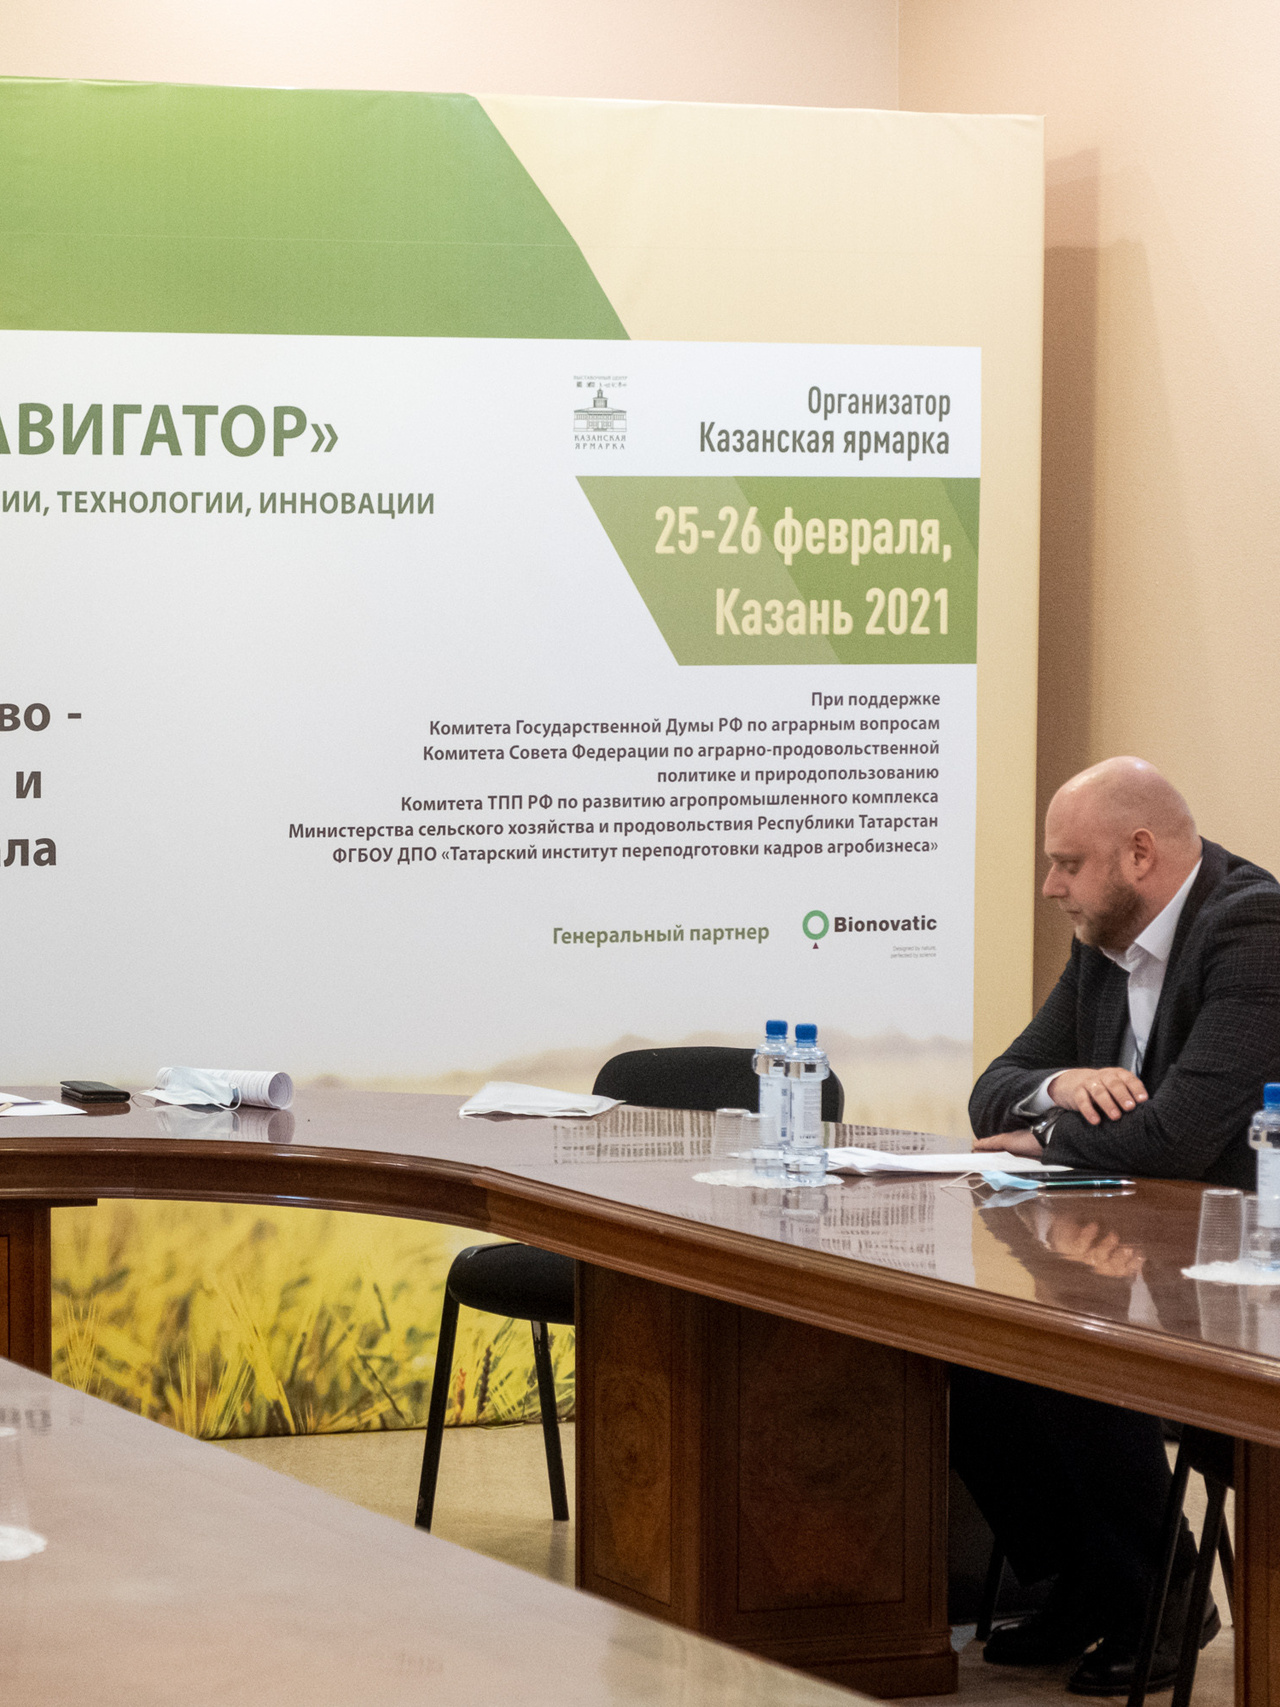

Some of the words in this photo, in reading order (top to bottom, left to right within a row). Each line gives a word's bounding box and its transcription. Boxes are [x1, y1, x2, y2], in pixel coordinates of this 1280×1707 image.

[807, 385, 951, 423] Организатор
[700, 421, 835, 454] Казанская
[843, 430, 950, 462] ярмарка
[56, 490, 252, 517] ТЕХНОЛОГИИ,
[259, 492, 434, 520] ИННОВАЦИИ
[655, 505, 762, 555] 25-26
[773, 506, 952, 566] февраля,
[715, 587, 854, 636] Казань
[865, 587, 948, 635] 2021
[811, 691, 844, 710] При
[848, 694, 941, 710] поддержке
[429, 720, 511, 736] Комитета
[515, 718, 662, 738] Государственной
[665, 717, 714, 737] Думы
[718, 716, 743, 733] РФ
[747, 720, 768, 732] по
[771, 719, 856, 735] аграрным
[859, 718, 940, 734] вопросам
[423, 745, 505, 761] Комитета
[508, 744, 568, 760] Совета
[571, 743, 669, 763] Федерации
[673, 746, 694, 758] по
[697, 740, 940, 761] аграрно-продовольственной
[15, 770, 42, 799] и
[657, 770, 737, 783] политике
[740, 770, 751, 782] и
[754, 767, 940, 785] природопользованию
[401, 796, 483, 812] Комитета
[487, 794, 523, 810] ТПП
[528, 794, 553, 810] РФ
[557, 797, 579, 809] по
[582, 796, 666, 813] развитию
[669, 793, 848, 811] агропромышленного
[852, 792, 939, 805] комплекса
[288, 823, 414, 841] Министерства
[418, 823, 504, 837] сельского
[508, 819, 595, 835] хозяйства
[598, 822, 609, 834] и
[613, 819, 753, 837] продовольствия
[757, 814, 855, 834] Республики
[858, 814, 938, 832] Татарстан
[332, 847, 394, 864] ФГБОУ
[397, 846, 437, 865] ДПО
[441, 844, 538, 864] «Татарский
[541, 846, 618, 862] институт
[622, 844, 759, 862] переподготовки
[763, 842, 824, 858] кадров
[827, 837, 938, 857] агробизнеса»
[553, 924, 685, 948] Генеральный
[689, 926, 770, 945] партнер
[834, 914, 937, 933] Bionovatic
